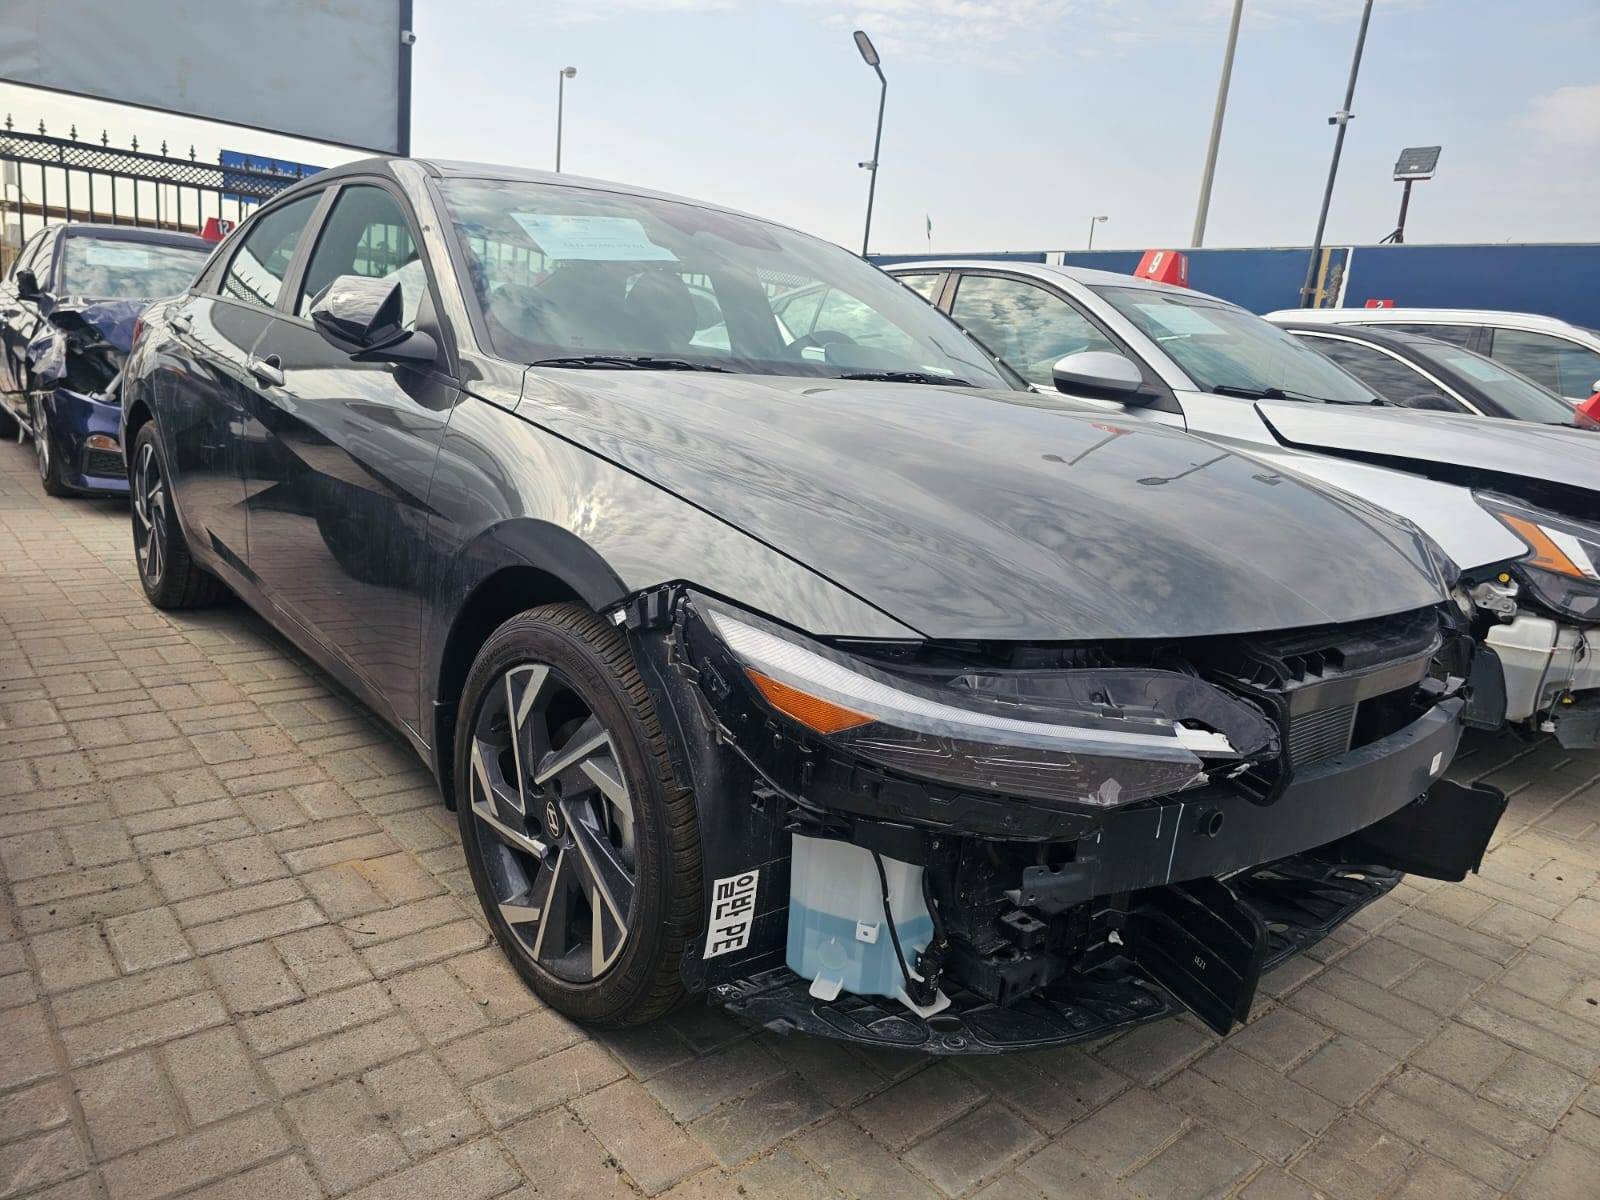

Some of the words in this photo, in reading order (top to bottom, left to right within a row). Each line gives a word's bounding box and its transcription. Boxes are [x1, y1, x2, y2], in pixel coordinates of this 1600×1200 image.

[1148, 252, 1163, 273] 9
[715, 875, 754, 920] 일반
[712, 922, 747, 953] PE
